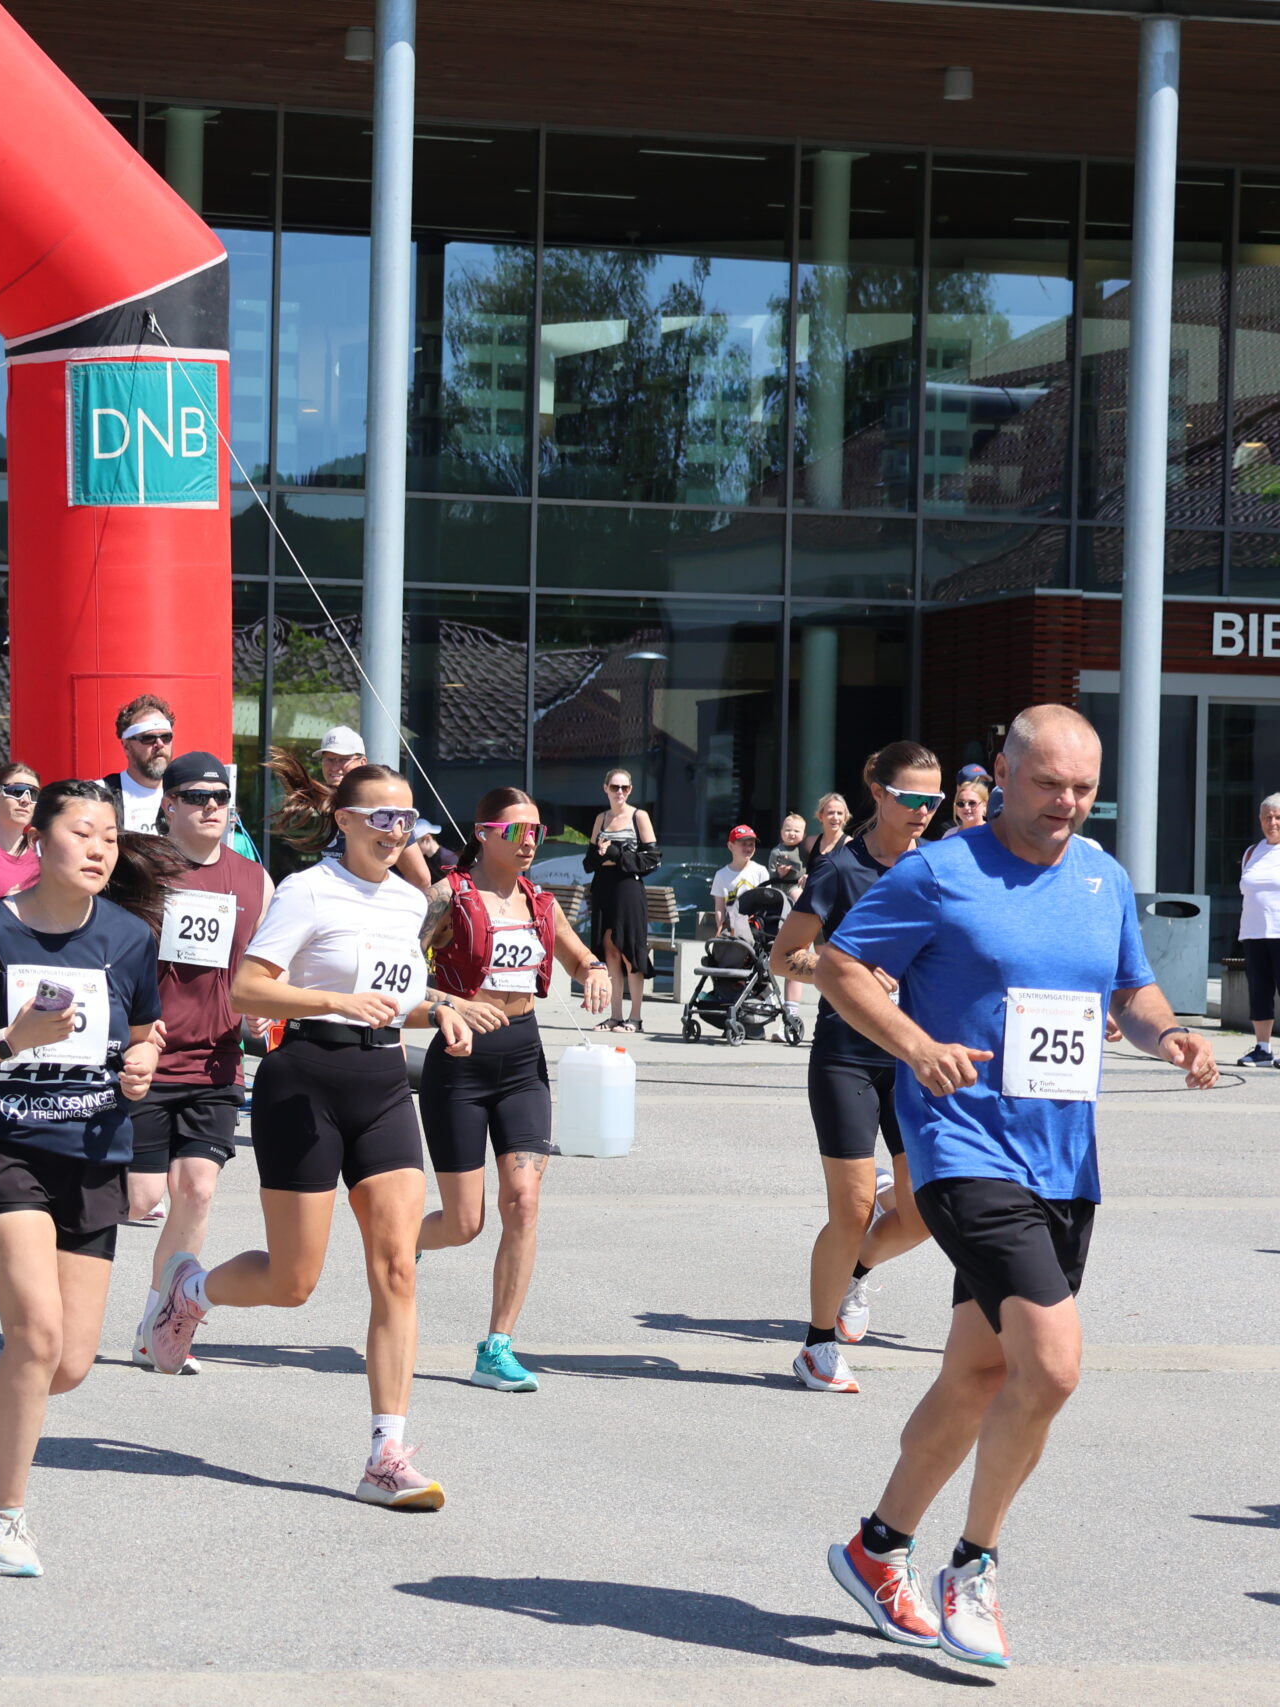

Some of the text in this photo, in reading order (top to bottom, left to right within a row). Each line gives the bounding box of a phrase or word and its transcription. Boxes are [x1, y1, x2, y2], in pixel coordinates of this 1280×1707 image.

[178, 915, 220, 943] 239
[493, 943, 532, 968] 232
[370, 961, 412, 993] 249
[1029, 1027, 1084, 1065] 255
[30, 1090, 116, 1110] KONGSVINGER
